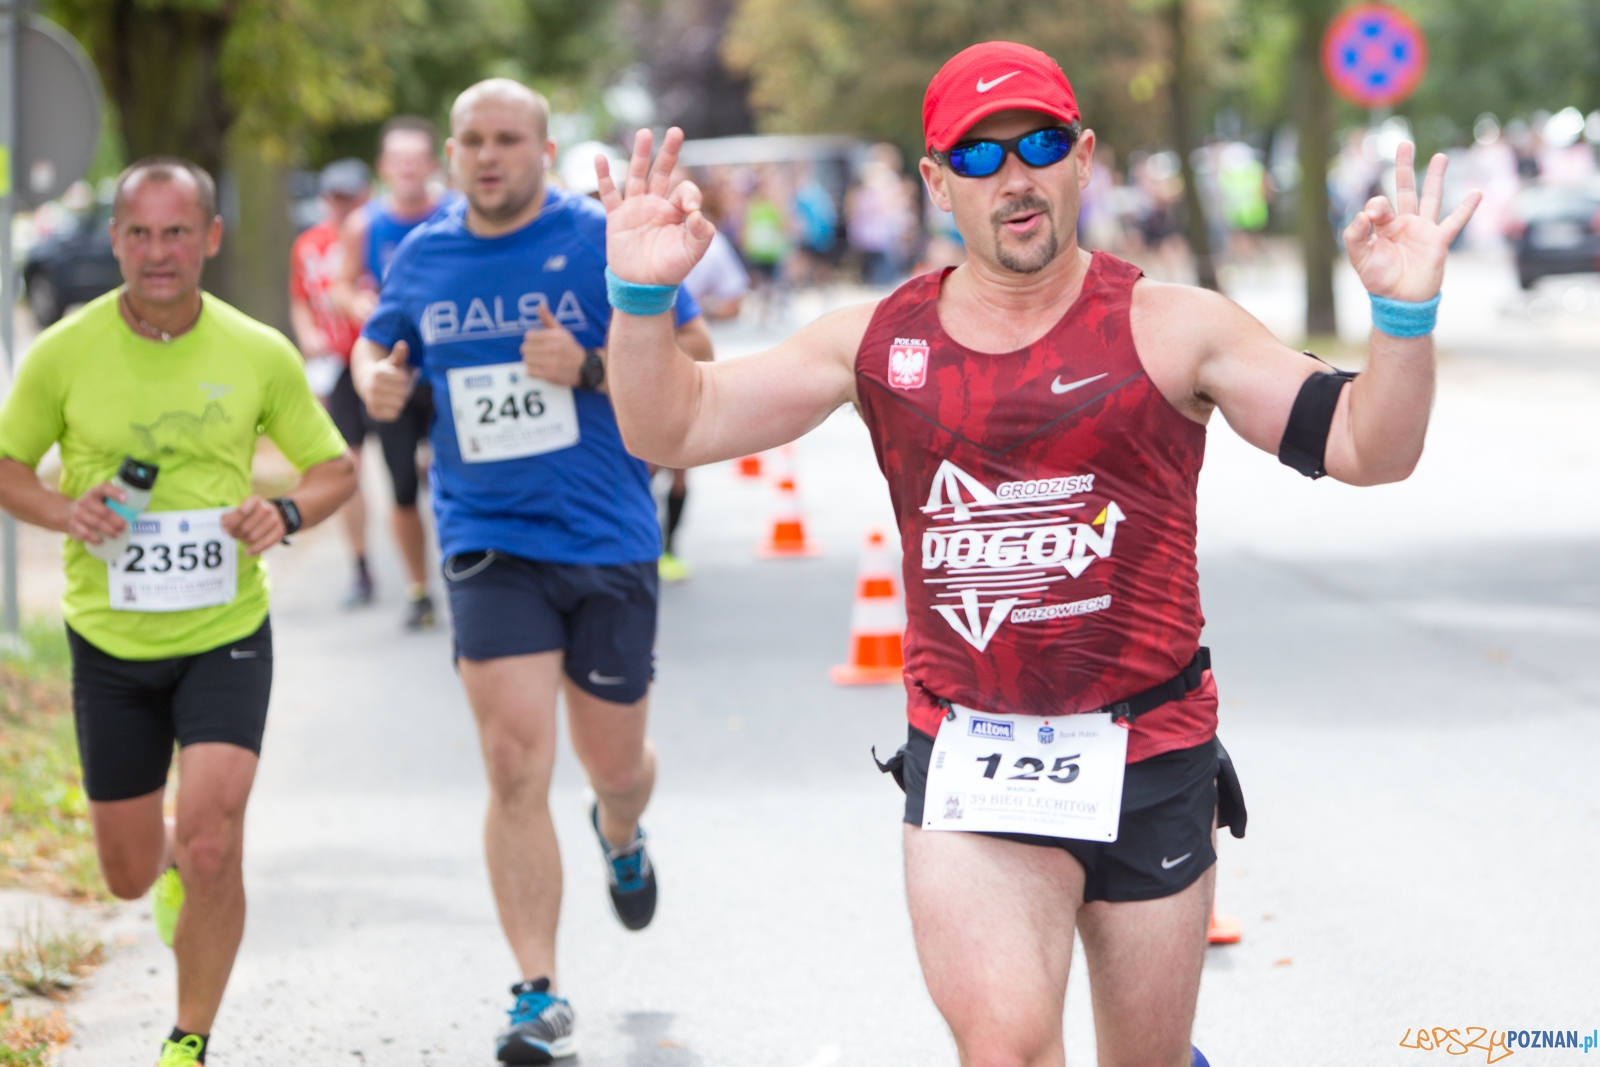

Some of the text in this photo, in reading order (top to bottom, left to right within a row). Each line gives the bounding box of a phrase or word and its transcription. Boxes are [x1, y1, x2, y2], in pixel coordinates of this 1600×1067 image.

[433, 289, 587, 336] BALSA
[893, 337, 928, 347] POLSKA
[476, 389, 546, 426] 246
[997, 474, 1095, 499] GRODZISK
[922, 505, 1122, 574] DOGON
[123, 540, 223, 573] 2358
[1010, 594, 1112, 623] MAZOWIECKI
[975, 753, 1081, 784] 125
[969, 793, 987, 805] 39
[990, 794, 1023, 807] BIEG
